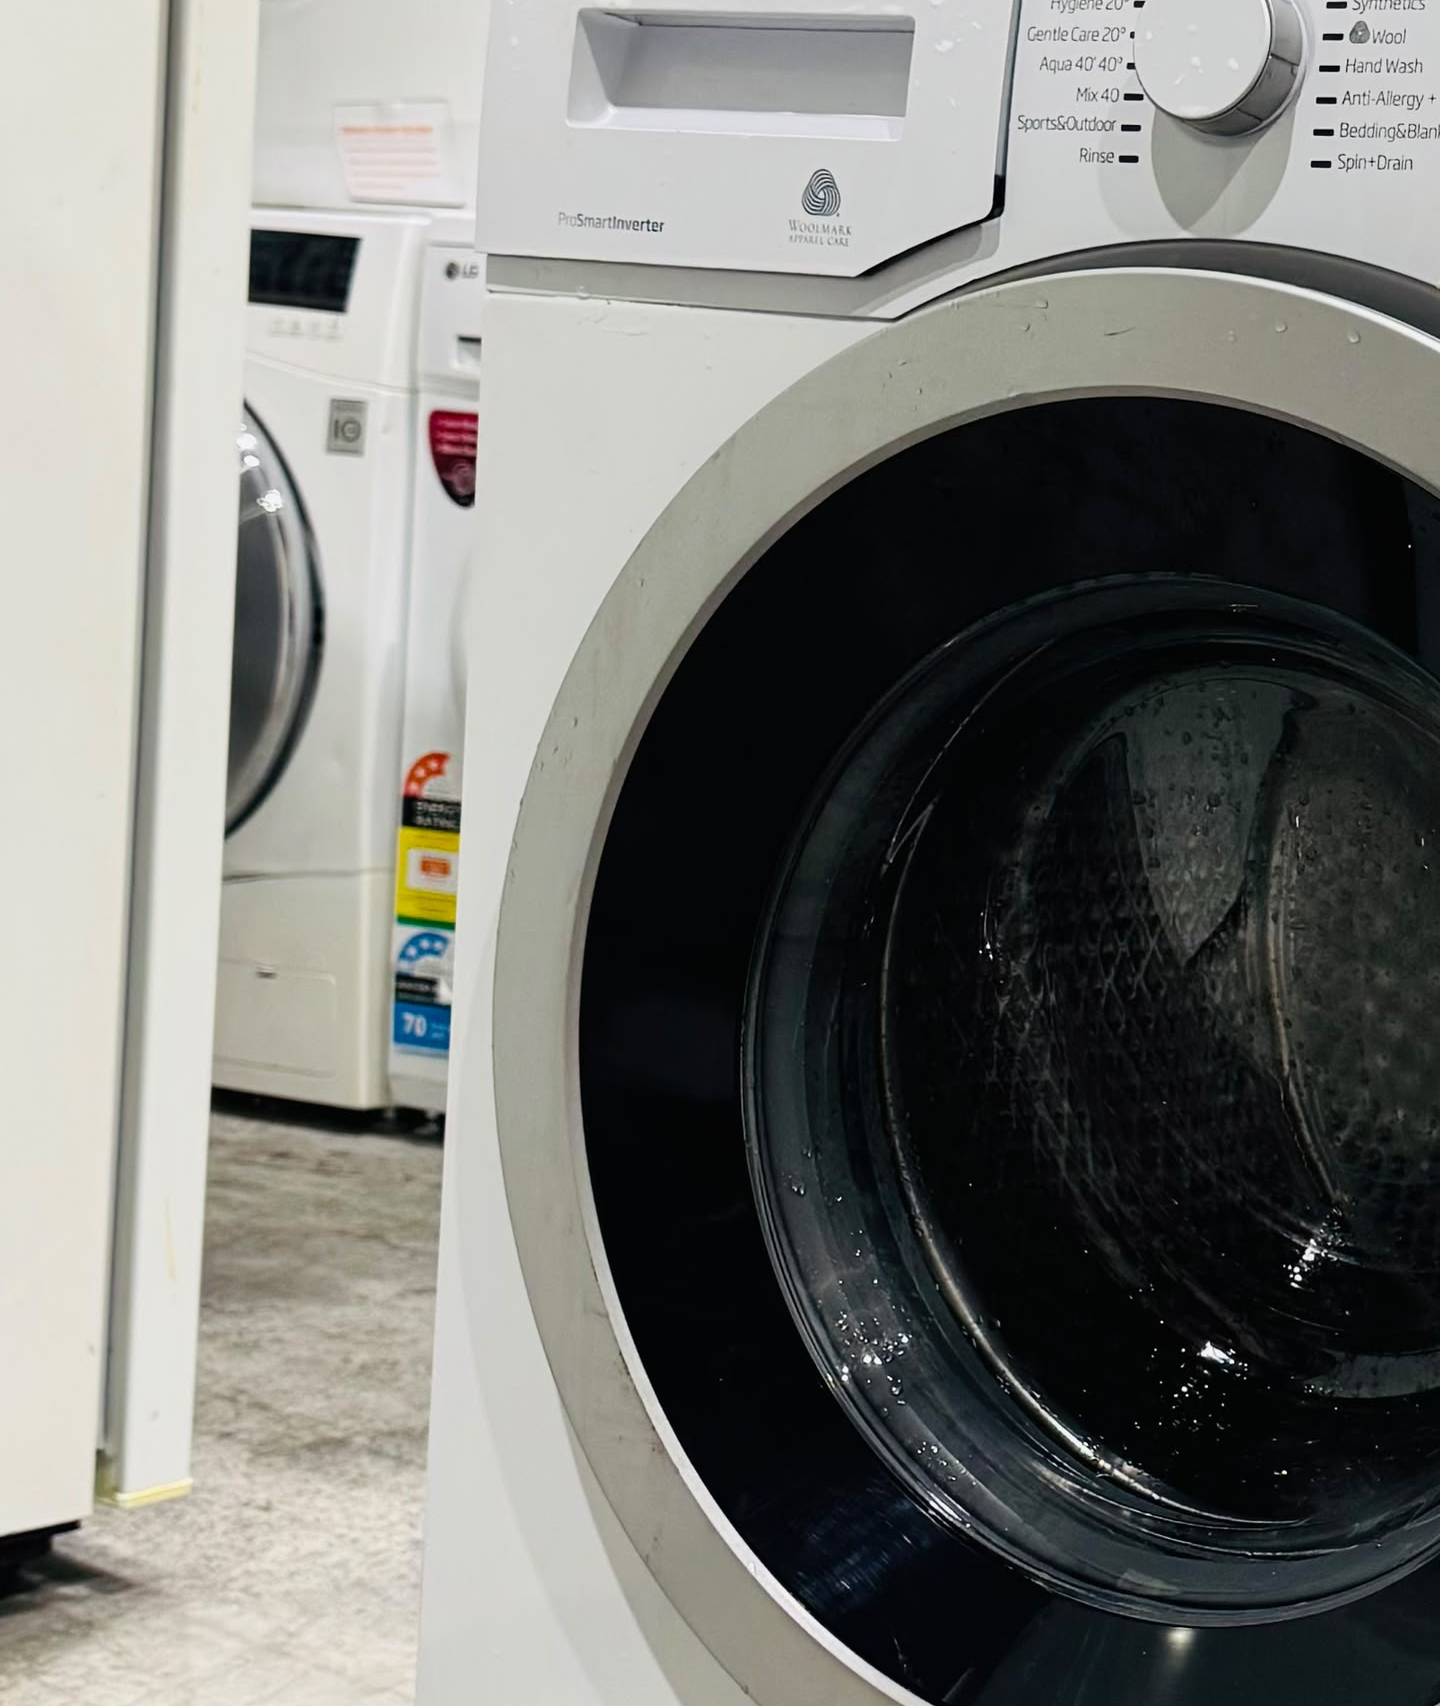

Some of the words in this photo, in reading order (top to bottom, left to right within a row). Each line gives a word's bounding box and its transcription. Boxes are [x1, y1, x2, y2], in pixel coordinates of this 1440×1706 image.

[1027, 26, 1069, 43] Gentle
[1070, 27, 1100, 43] Care
[1372, 29, 1407, 44] Wool
[1039, 56, 1073, 75] Aqua
[1345, 58, 1382, 74] Hand
[1385, 58, 1423, 74] Wash
[1076, 87, 1098, 103] Mix
[1100, 87, 1120, 103] 40
[1341, 90, 1424, 111] Anti-Allergy
[1017, 115, 1117, 133] Sports&Outdoor
[1079, 147, 1115, 164] Rinse
[1337, 153, 1413, 173] Spin+Drain
[558, 211, 665, 233] ProSmartInverter
[788, 218, 853, 236] WOOLMARK
[826, 236, 849, 247] CARE
[401, 1011, 428, 1039] 70
